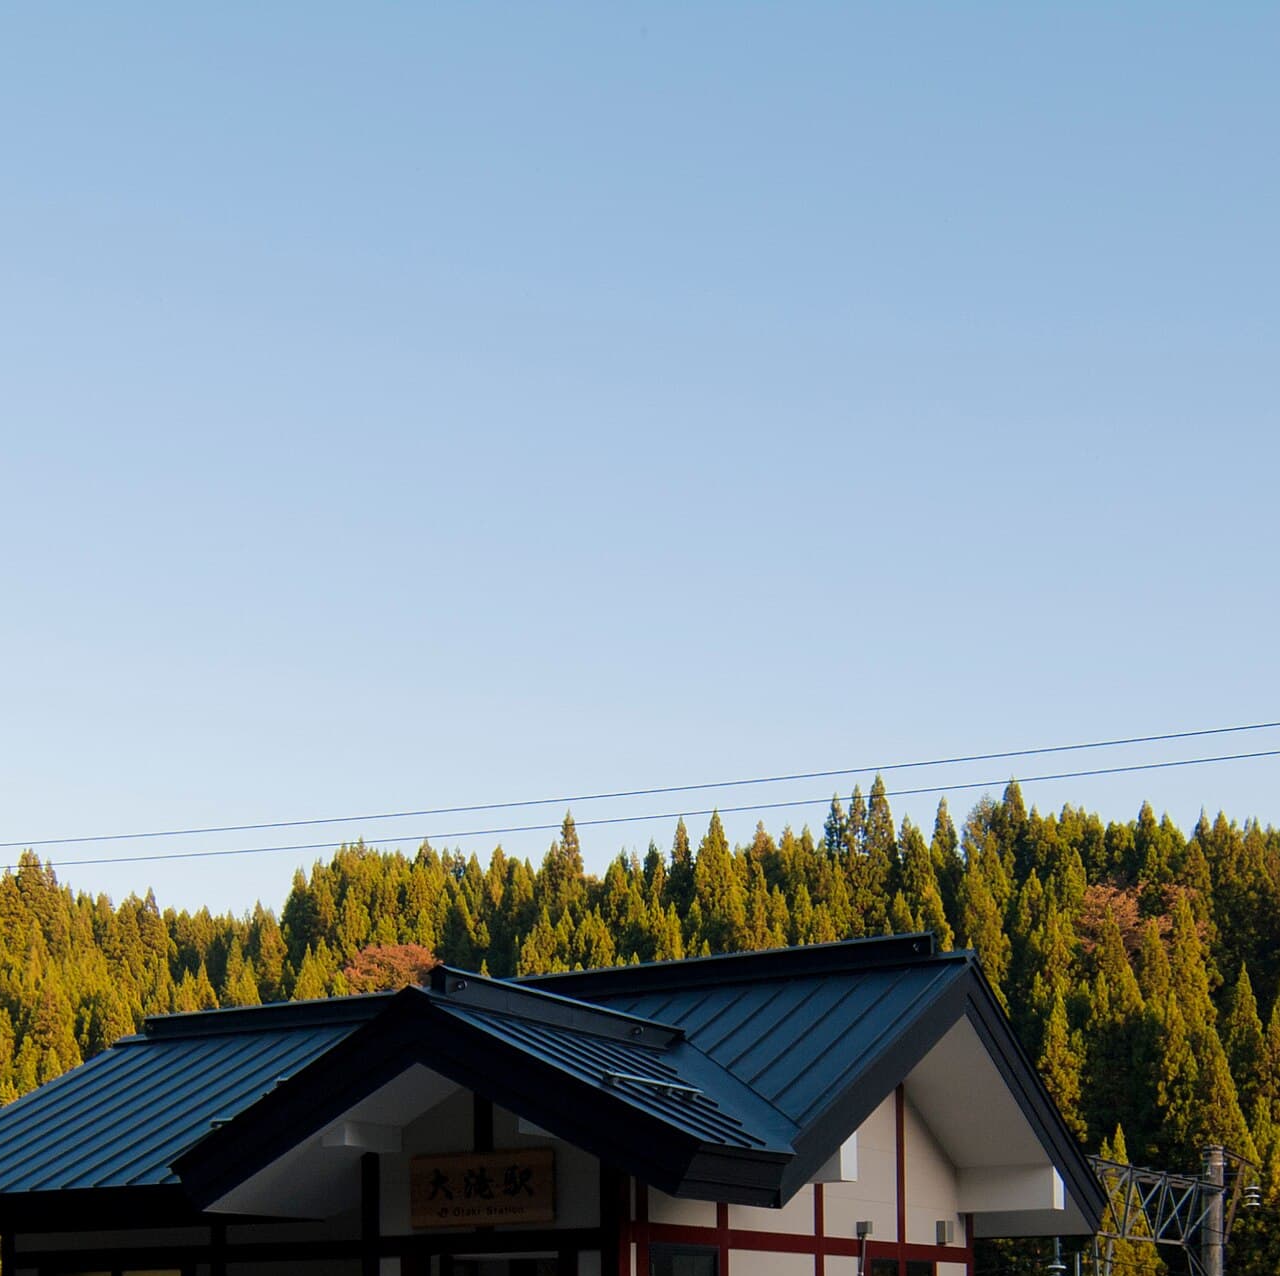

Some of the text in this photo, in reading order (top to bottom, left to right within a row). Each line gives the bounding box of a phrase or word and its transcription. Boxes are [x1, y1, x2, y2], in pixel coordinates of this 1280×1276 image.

[429, 1164, 534, 1200] 大滝駅
[486, 1205, 524, 1216] Station
